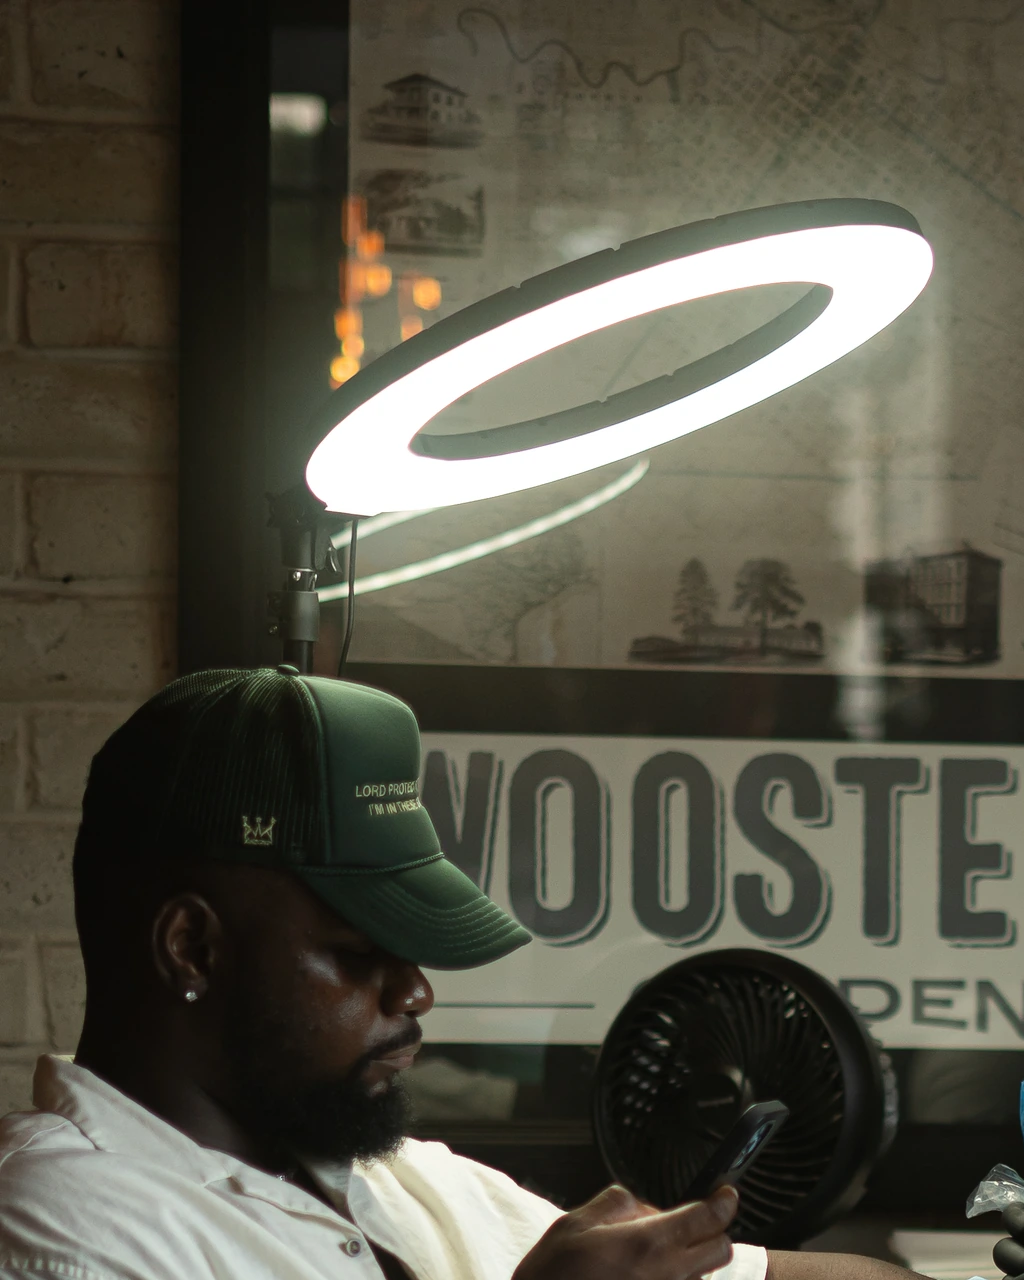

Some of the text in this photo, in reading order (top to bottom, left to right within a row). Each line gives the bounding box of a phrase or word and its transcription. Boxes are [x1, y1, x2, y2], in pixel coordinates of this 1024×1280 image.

[355, 785, 387, 797] LORD
[368, 803, 385, 815] I'M
[386, 802, 398, 814] IN
